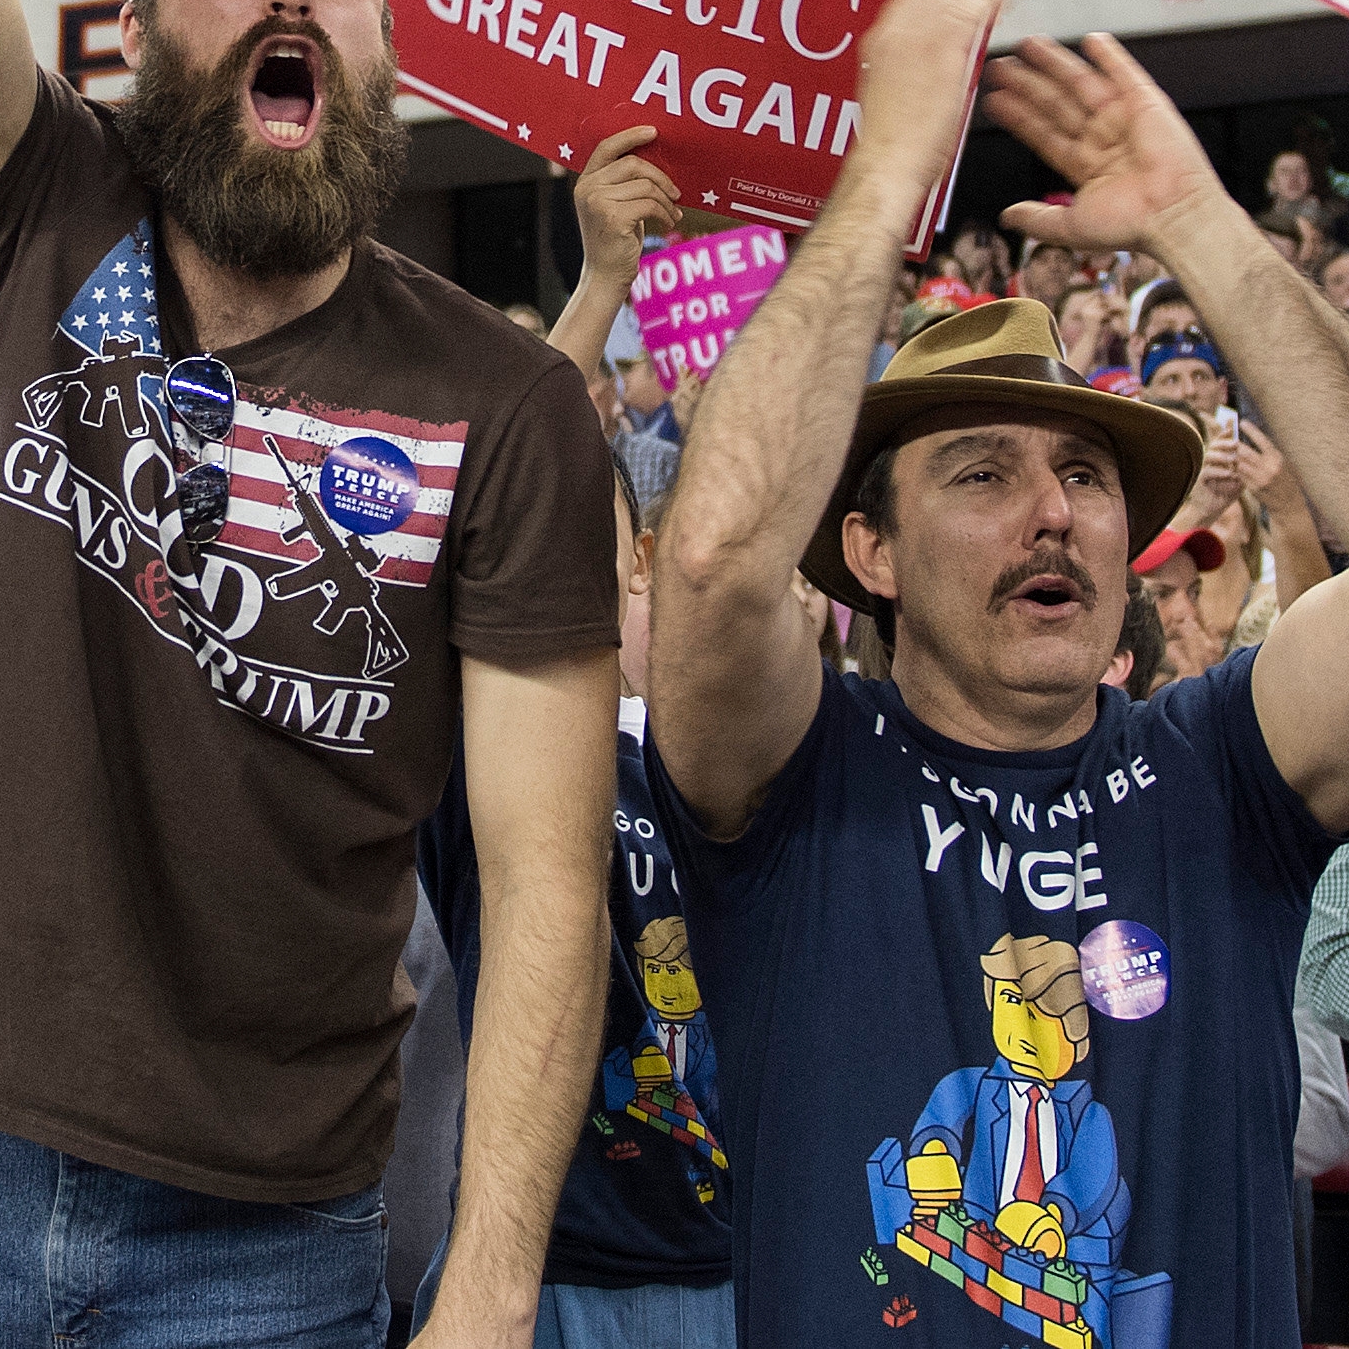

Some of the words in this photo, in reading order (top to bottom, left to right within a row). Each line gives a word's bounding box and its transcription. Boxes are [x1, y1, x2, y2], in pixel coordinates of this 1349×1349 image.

[632, 50, 864, 156] AGAIN
[736, 182, 754, 192] Paid
[755, 185, 766, 195] for
[766, 188, 777, 199] by
[778, 192, 807, 205] Donald
[631, 230, 785, 302] WOMEN
[670, 292, 730, 329] FOR
[653, 329, 735, 380] TRU
[332, 465, 410, 494] TRUMP
[335, 480, 400, 503] PENCE
[334, 494, 357, 505] MAKE
[358, 500, 394, 515] AMERICA
[334, 501, 361, 512] GREAT
[362, 509, 392, 521] AGAIN!
[3, 437, 131, 570] GUNS
[135, 559, 173, 618] &
[1105, 755, 1157, 804] BE
[921, 803, 1108, 912] YUGE
[1086, 951, 1162, 980] TRUMP
